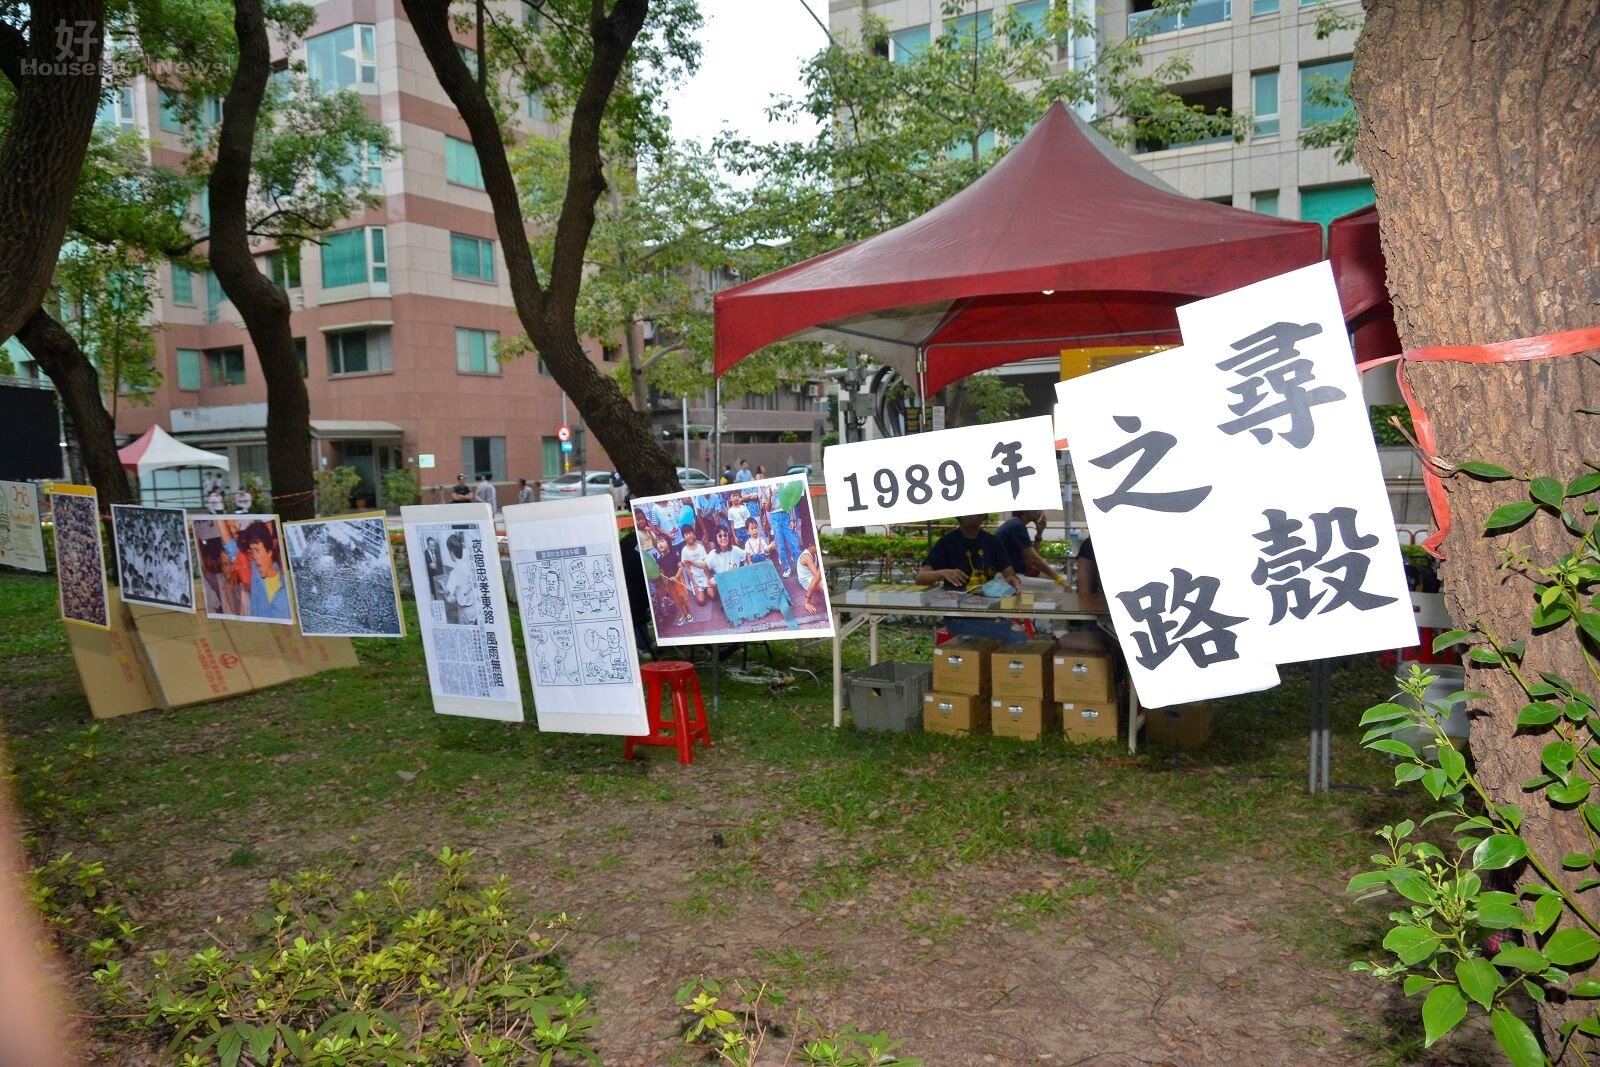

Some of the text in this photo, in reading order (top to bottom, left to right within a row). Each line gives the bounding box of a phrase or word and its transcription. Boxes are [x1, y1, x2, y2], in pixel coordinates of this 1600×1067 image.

[843, 440, 1036, 513] 1989 年
[1088, 415, 1249, 671] 之路
[1216, 321, 1398, 626] 尋殼
